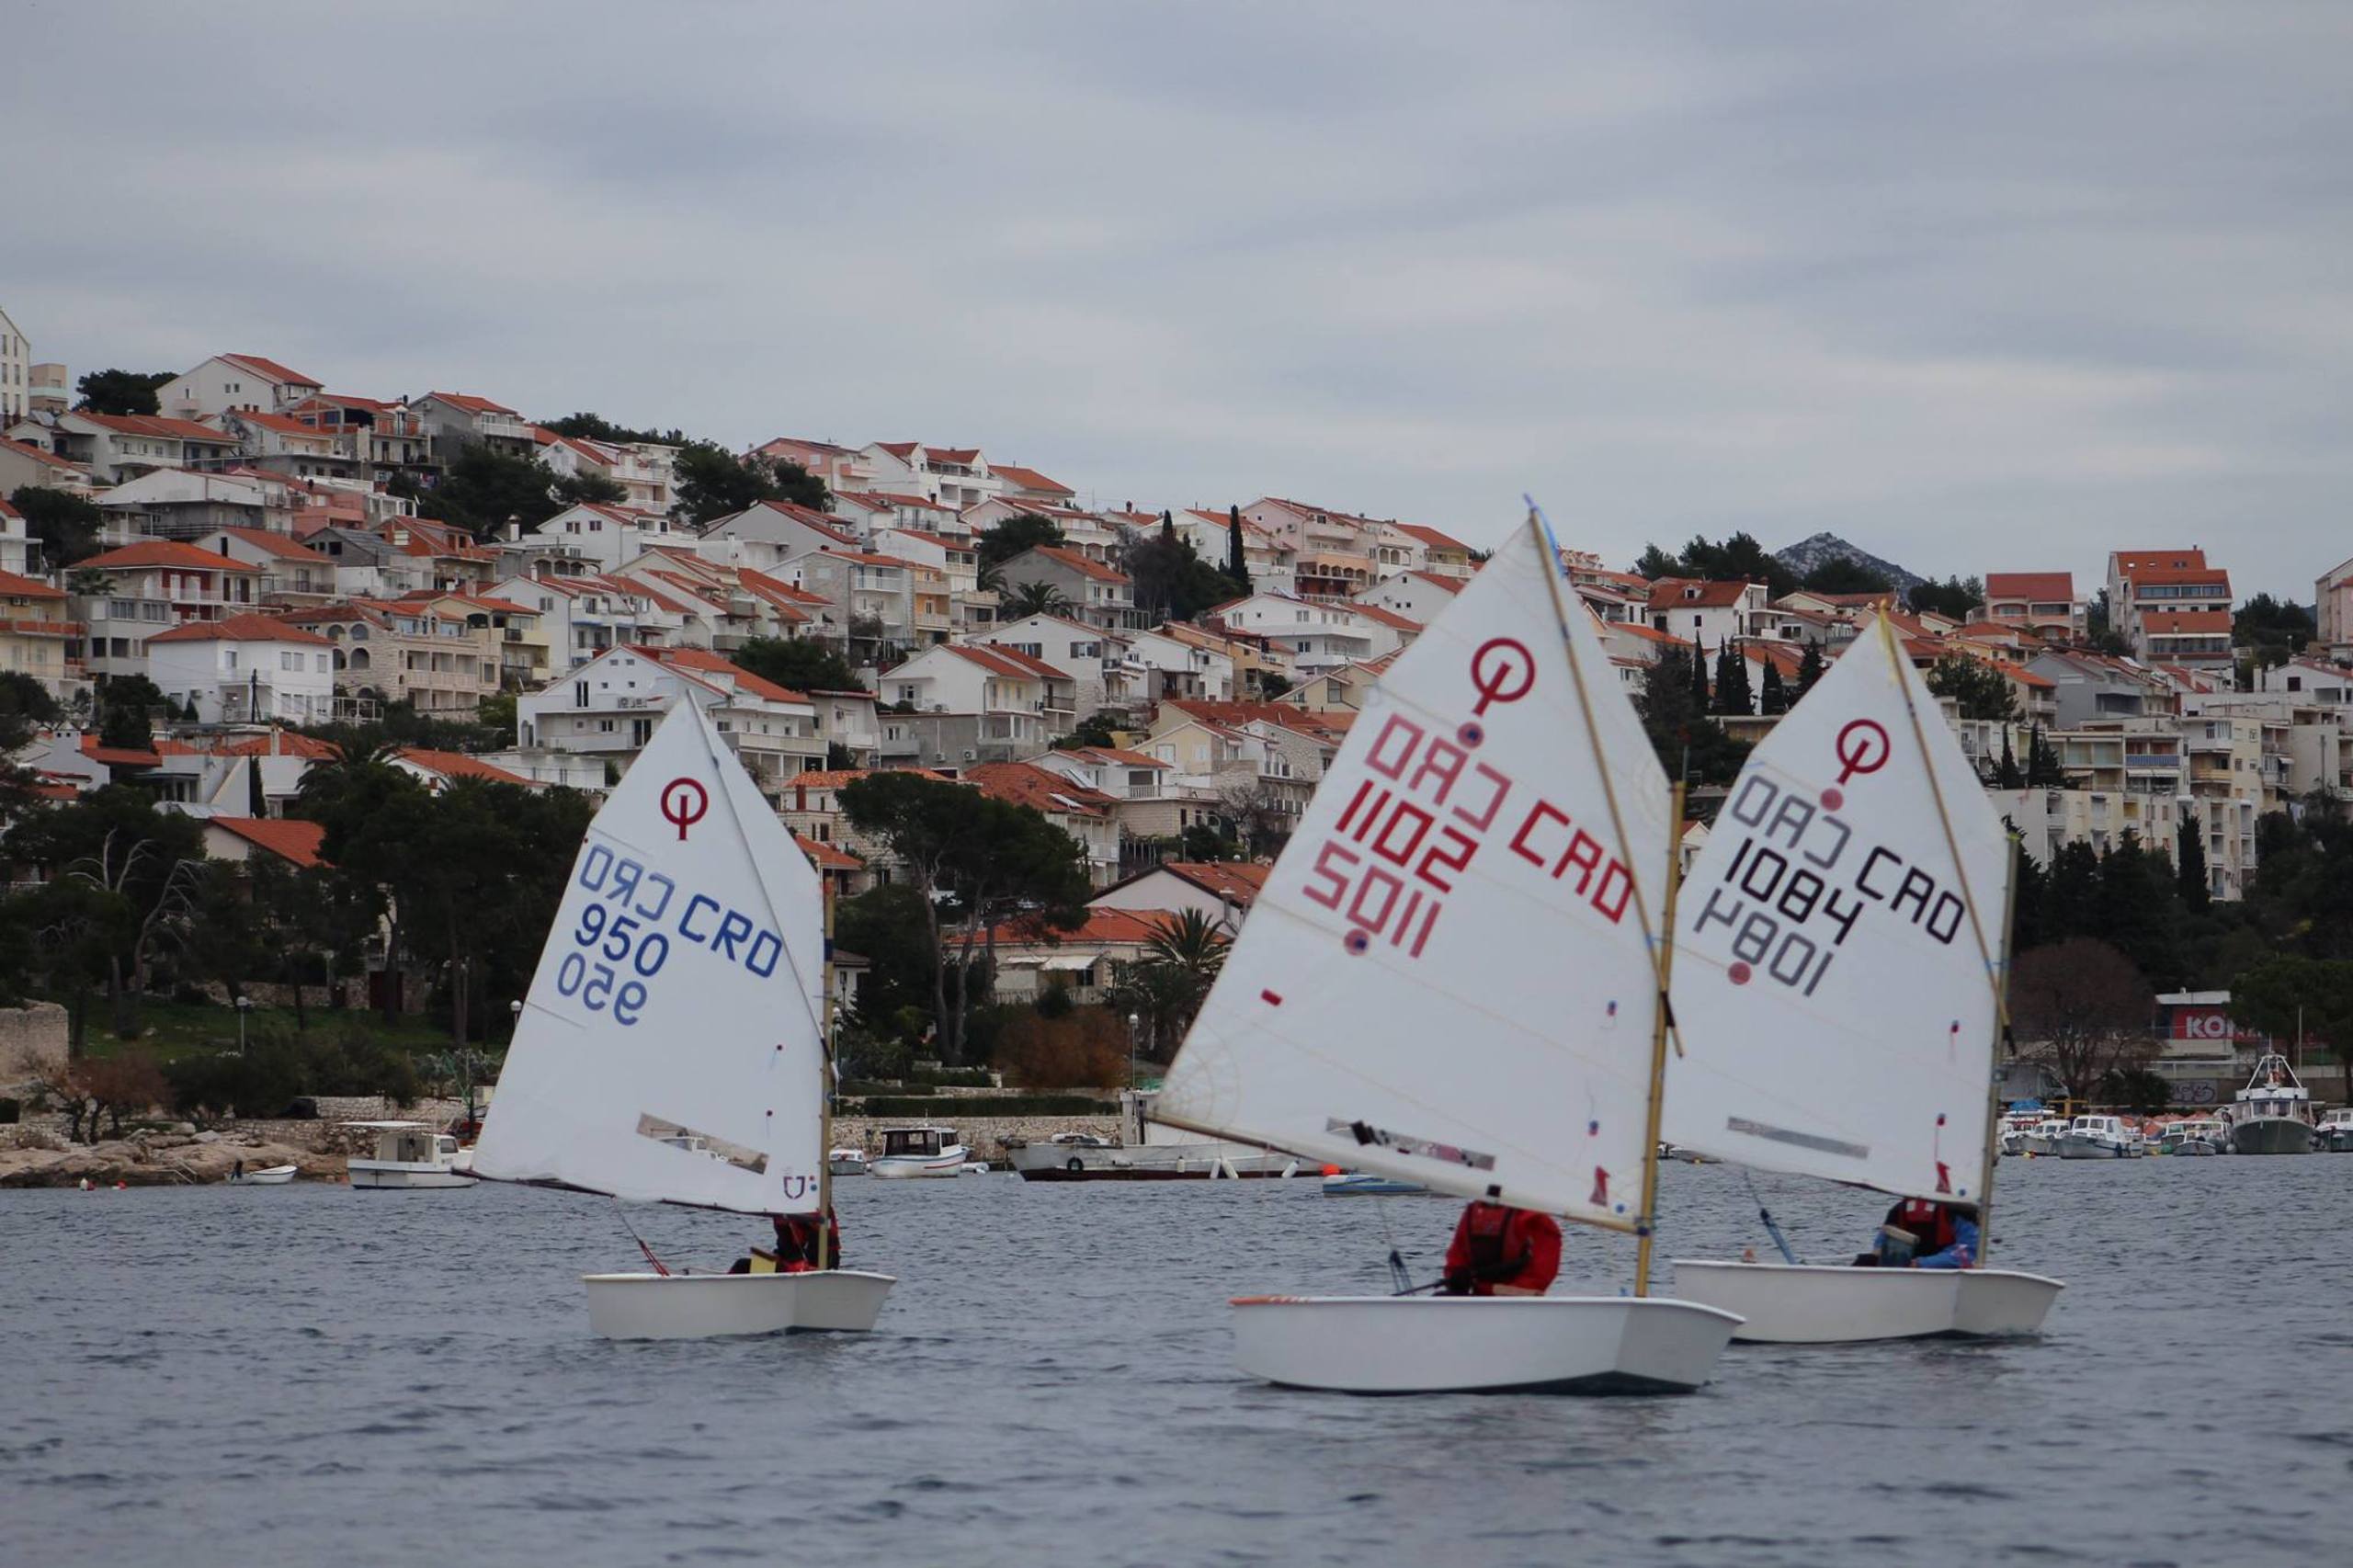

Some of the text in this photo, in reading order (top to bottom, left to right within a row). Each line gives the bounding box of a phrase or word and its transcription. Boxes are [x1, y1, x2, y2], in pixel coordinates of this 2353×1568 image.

[1335, 779, 1480, 894] 1102
[574, 903, 669, 977] 950
[678, 893, 783, 978] CRO
[1723, 836, 1865, 947] 1084
